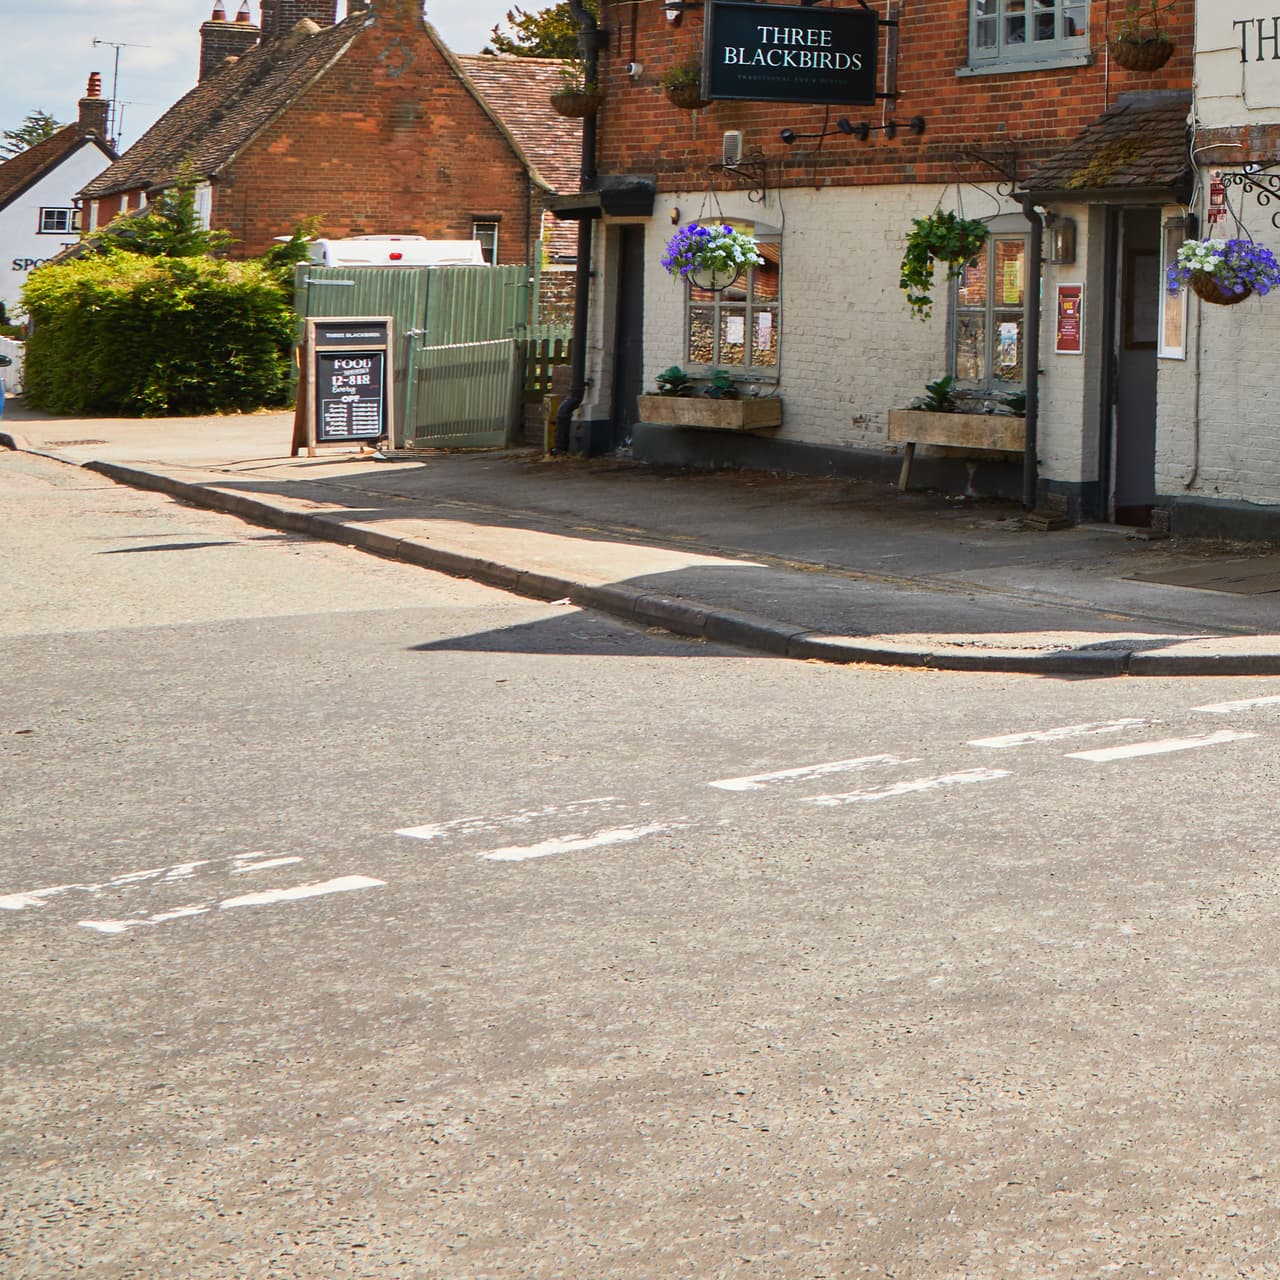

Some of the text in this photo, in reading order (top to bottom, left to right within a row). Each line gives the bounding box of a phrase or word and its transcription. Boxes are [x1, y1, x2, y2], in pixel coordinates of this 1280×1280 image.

[757, 25, 832, 47] THREE
[723, 46, 862, 71] BLACKBIRDS
[12, 258, 53, 271] SPO
[334, 359, 371, 369] FOOD
